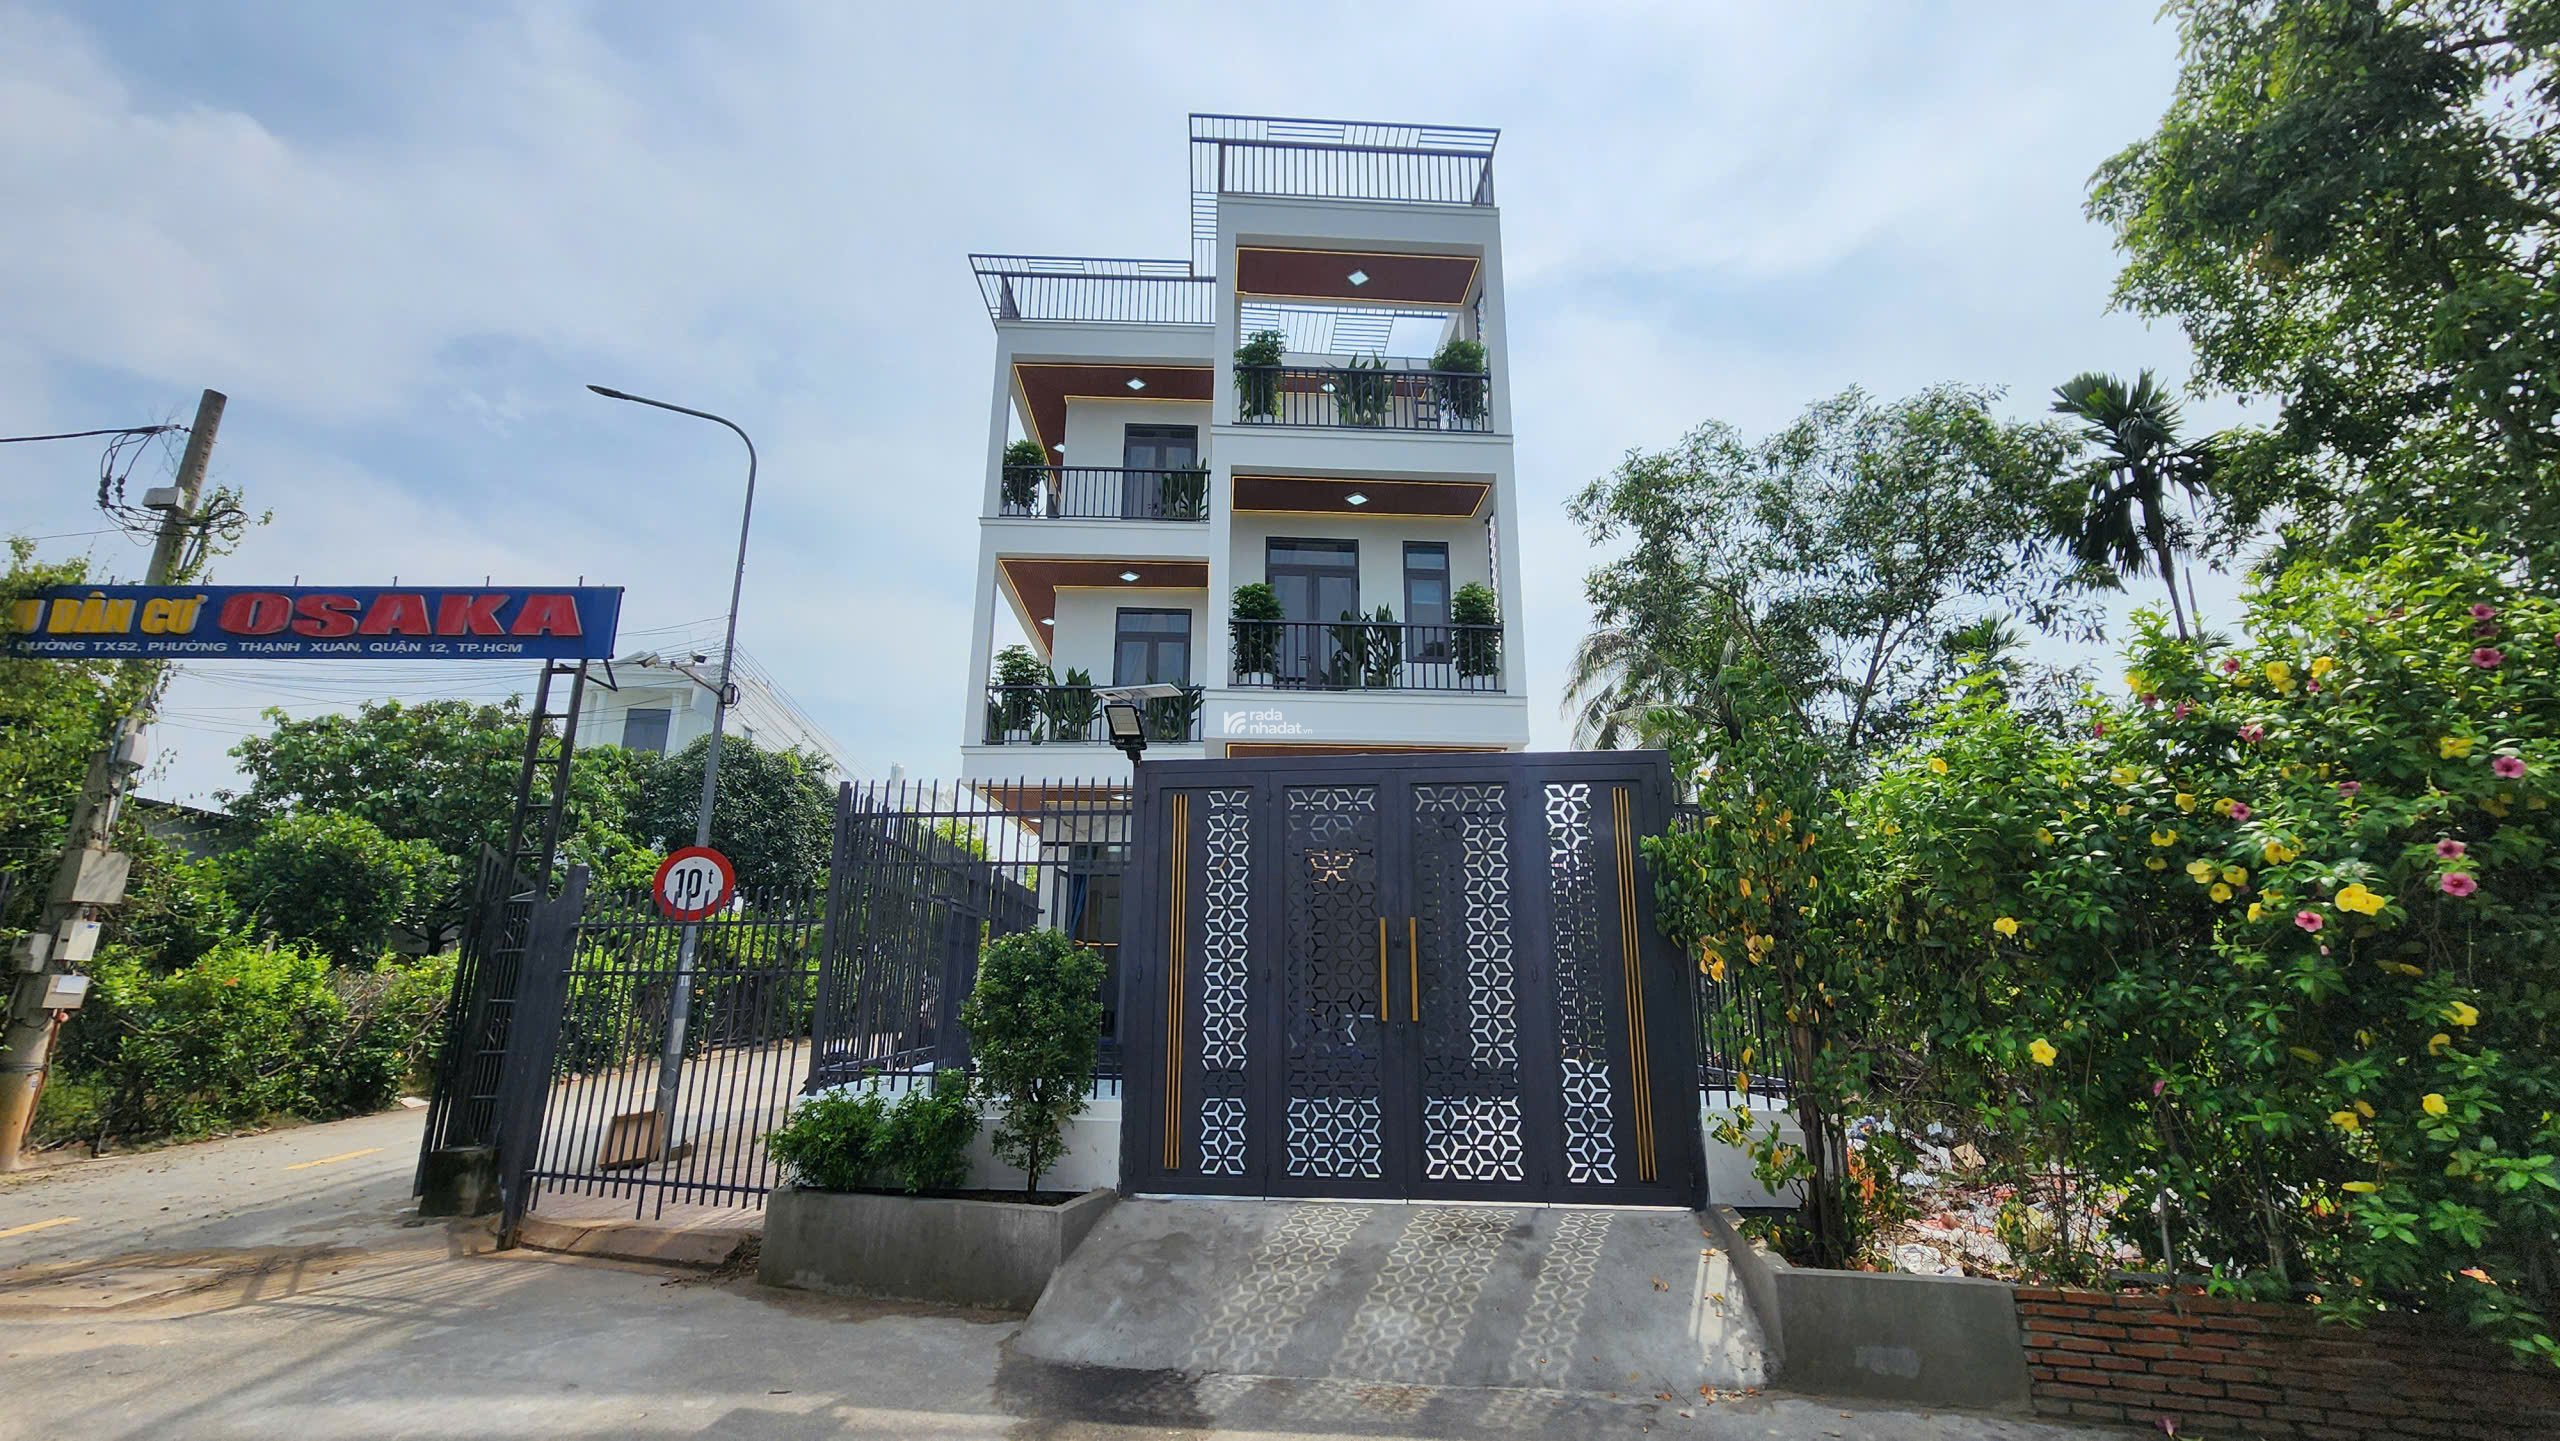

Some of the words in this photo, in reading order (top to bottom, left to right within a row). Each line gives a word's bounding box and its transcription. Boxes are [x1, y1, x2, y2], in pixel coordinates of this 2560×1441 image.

[47, 591, 137, 633] DÂN
[140, 594, 208, 634] CƯ
[218, 592, 583, 637] OSAKA
[93, 641, 142, 653] TX52,
[147, 639, 228, 652] PHƯỜNG
[239, 641, 301, 654] THẠNH
[369, 640, 421, 654] QUẬN
[428, 642, 449, 654] 12,
[456, 642, 523, 653] TP.HCM
